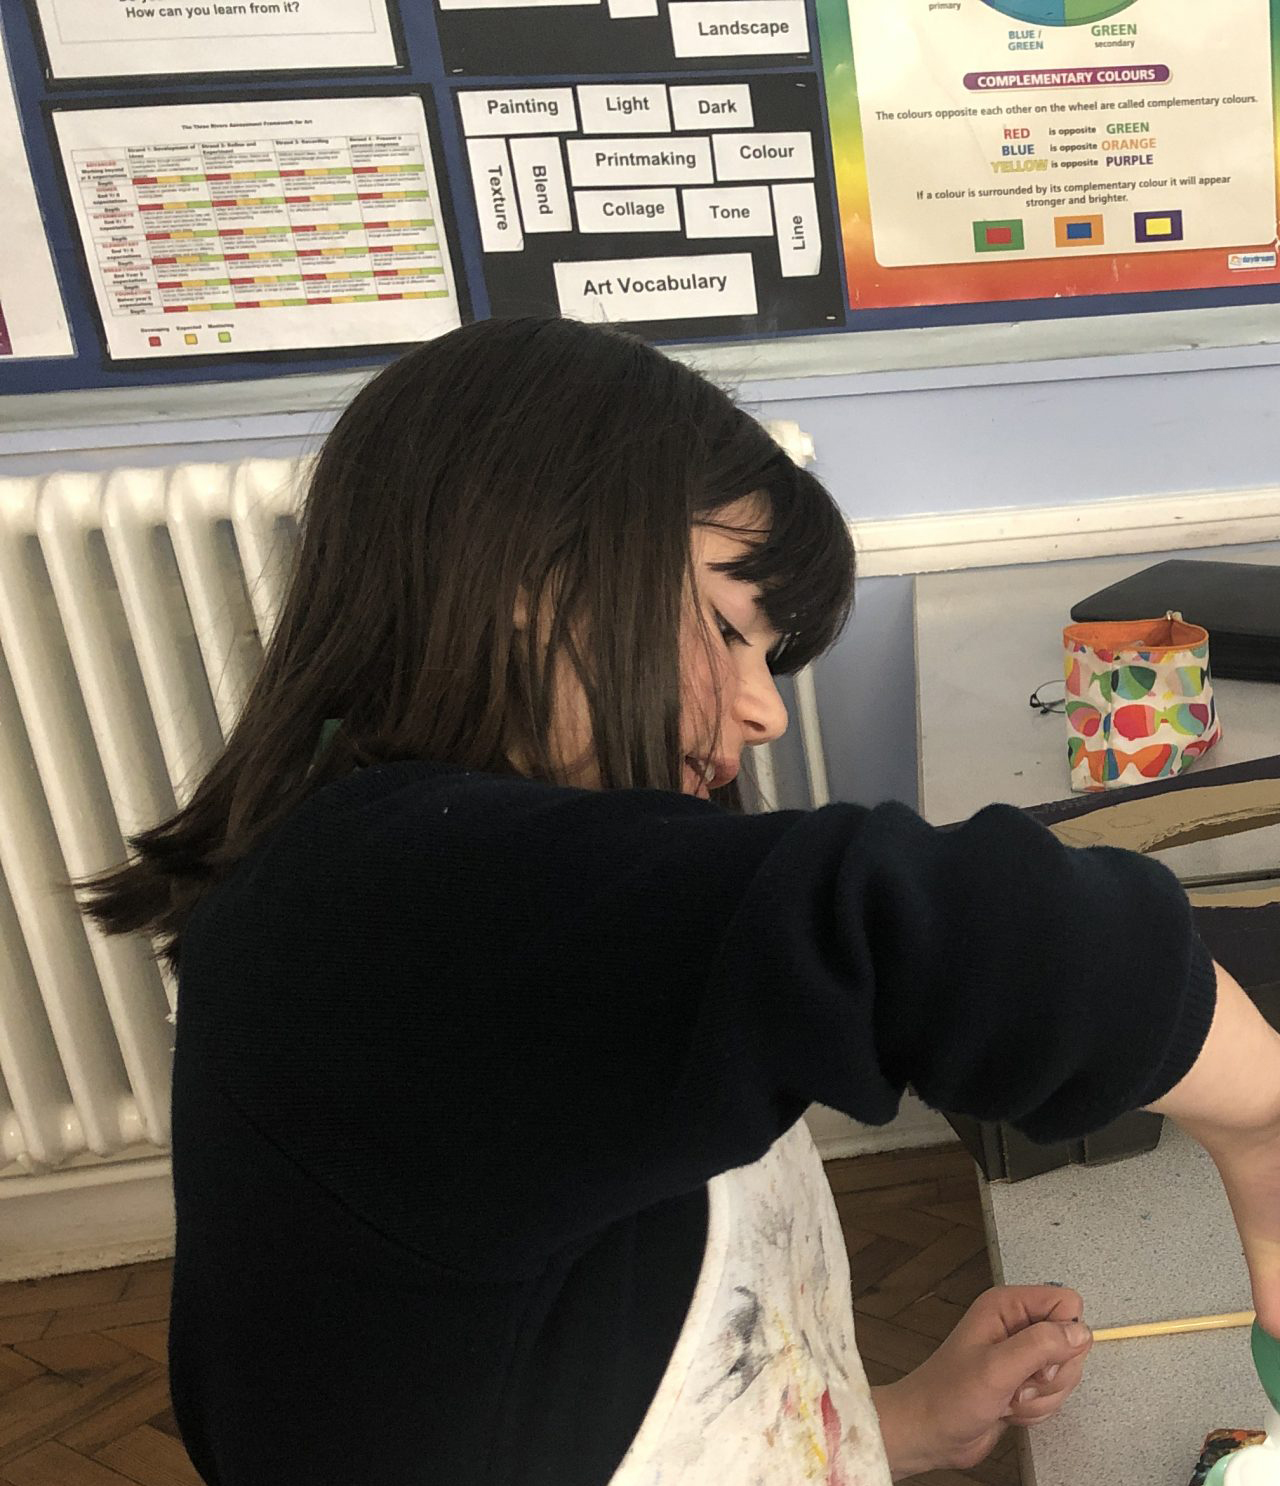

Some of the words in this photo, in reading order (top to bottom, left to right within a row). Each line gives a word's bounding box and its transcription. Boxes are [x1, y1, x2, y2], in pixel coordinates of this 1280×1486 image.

[126, 7, 155, 18] How
[159, 8, 182, 17] can
[185, 7, 210, 18] you
[214, 4, 246, 15] learn
[250, 2, 280, 14] from
[284, 2, 300, 13] it?
[928, 2, 961, 11] primary
[698, 20, 790, 38] Landscape
[1008, 30, 1036, 40] BLUE
[1091, 24, 1138, 37] GREEN
[1007, 40, 1044, 51] GREEN
[1095, 39, 1135, 48] secondary
[977, 72, 1093, 88] COMPLEMENTARY
[1096, 69, 1156, 83] COLOURS
[487, 98, 559, 116] Painting
[606, 96, 650, 114] Light
[698, 99, 737, 114] Dark
[876, 111, 894, 121] The
[897, 109, 932, 120] colours
[935, 107, 978, 119] opposite
[980, 105, 1003, 116] each
[1005, 104, 1032, 114] other
[1034, 105, 1048, 113] on
[1050, 103, 1066, 112] the
[1068, 101, 1097, 112] wheel
[1100, 102, 1115, 110] are
[1118, 99, 1145, 110] called
[1147, 96, 1220, 108] complementary
[1222, 94, 1259, 104] colours.
[1003, 128, 1030, 140] RED
[1048, 128, 1057, 136] is
[1058, 126, 1096, 136] opposite
[1106, 122, 1150, 134] GREEN
[740, 145, 795, 159] Colour
[1001, 144, 1035, 156] BLUE
[1049, 144, 1057, 152] is
[1059, 142, 1097, 152] opposite
[1101, 138, 1157, 151] ORANGE
[595, 152, 696, 169] Printmaking
[990, 158, 1048, 173] YELLOW
[1051, 160, 1058, 168] is
[1060, 159, 1098, 169] opposite
[1106, 154, 1153, 167] PURPLE
[532, 165, 553, 215] Blend
[916, 190, 924, 200] If
[935, 189, 965, 199] colour
[968, 188, 976, 197] is
[978, 185, 1033, 197] surrounded
[1035, 184, 1047, 196] by
[1050, 183, 1062, 193] its
[1063, 181, 1136, 193] complementary
[1138, 177, 1167, 187] colour
[1170, 177, 1177, 186] it
[1179, 176, 1196, 185] will
[1198, 175, 1231, 186] appear
[488, 165, 508, 231] Texture
[1025, 197, 1065, 208] stronger
[1068, 195, 1086, 204] and
[1088, 193, 1128, 204] brighter.
[602, 201, 665, 218] Collage
[709, 205, 751, 219] Tone
[792, 215, 806, 251] Line
[583, 277, 612, 296] Art
[617, 274, 728, 293] Vocabulary
